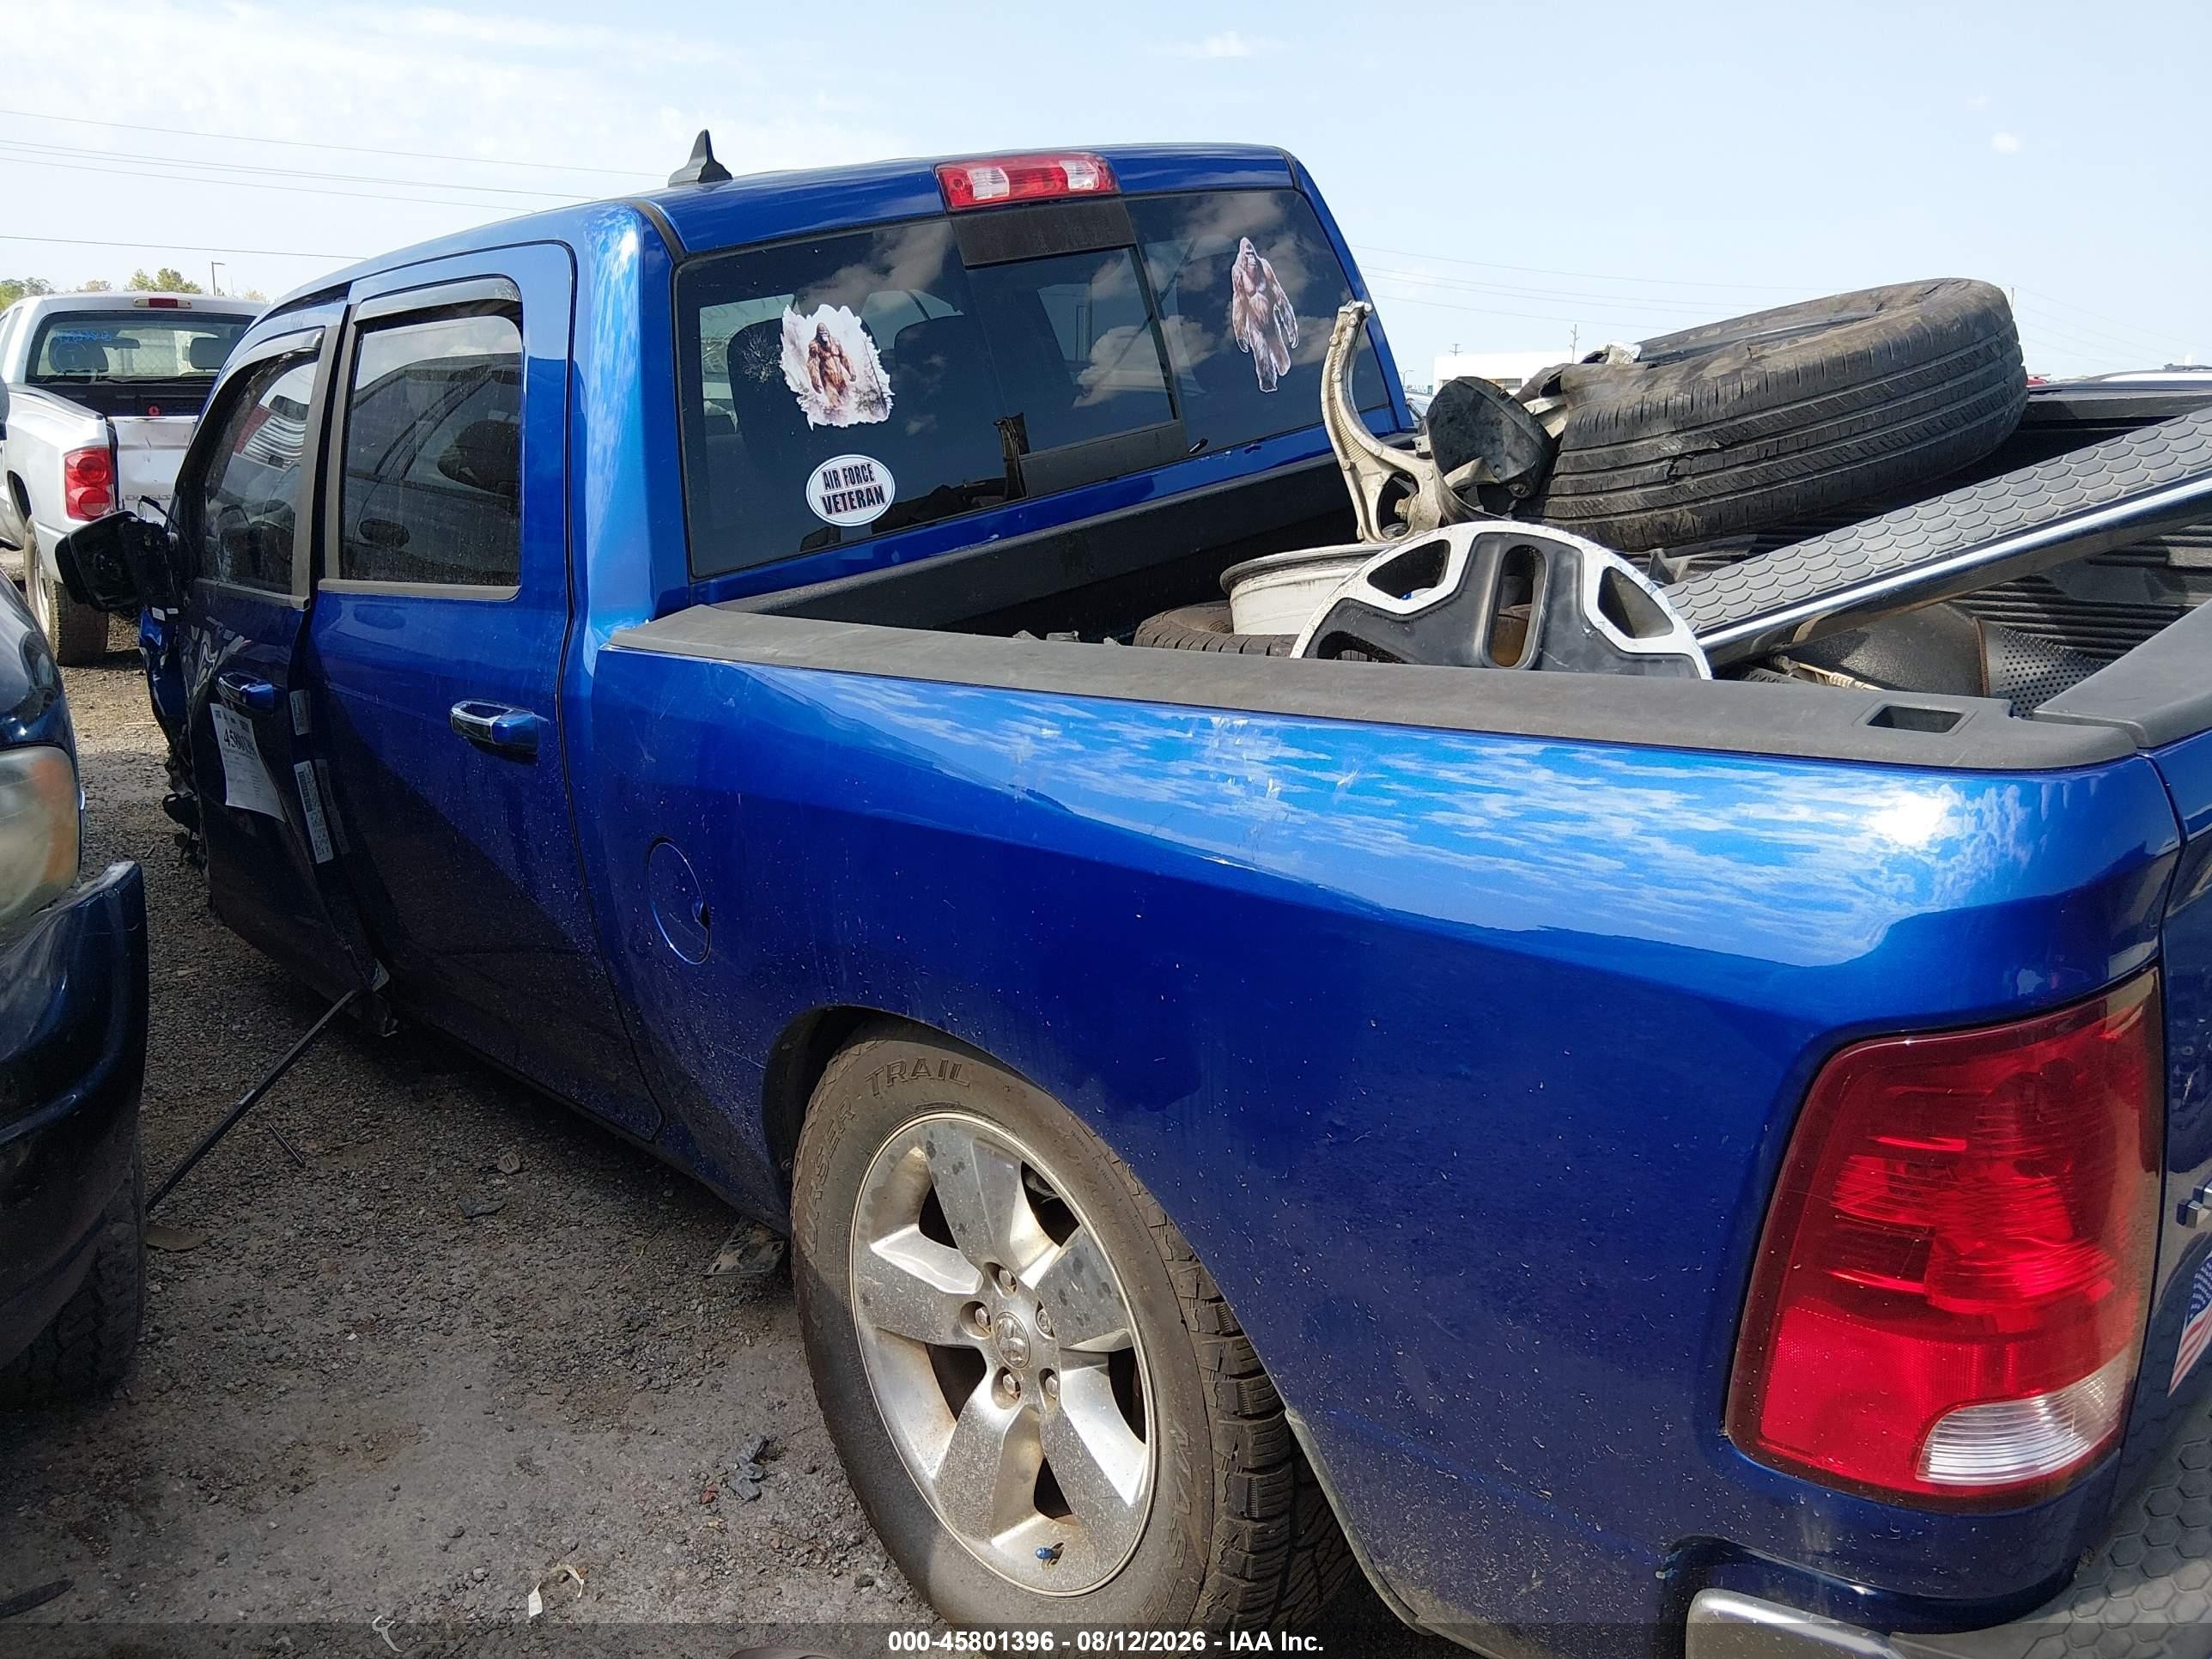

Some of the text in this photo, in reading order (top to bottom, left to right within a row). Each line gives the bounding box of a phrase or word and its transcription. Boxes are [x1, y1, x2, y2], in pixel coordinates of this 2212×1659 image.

[822, 462, 875, 491] AIR FORCE
[820, 484, 886, 515] VETERAN
[865, 1057, 970, 1098] TRAIL
